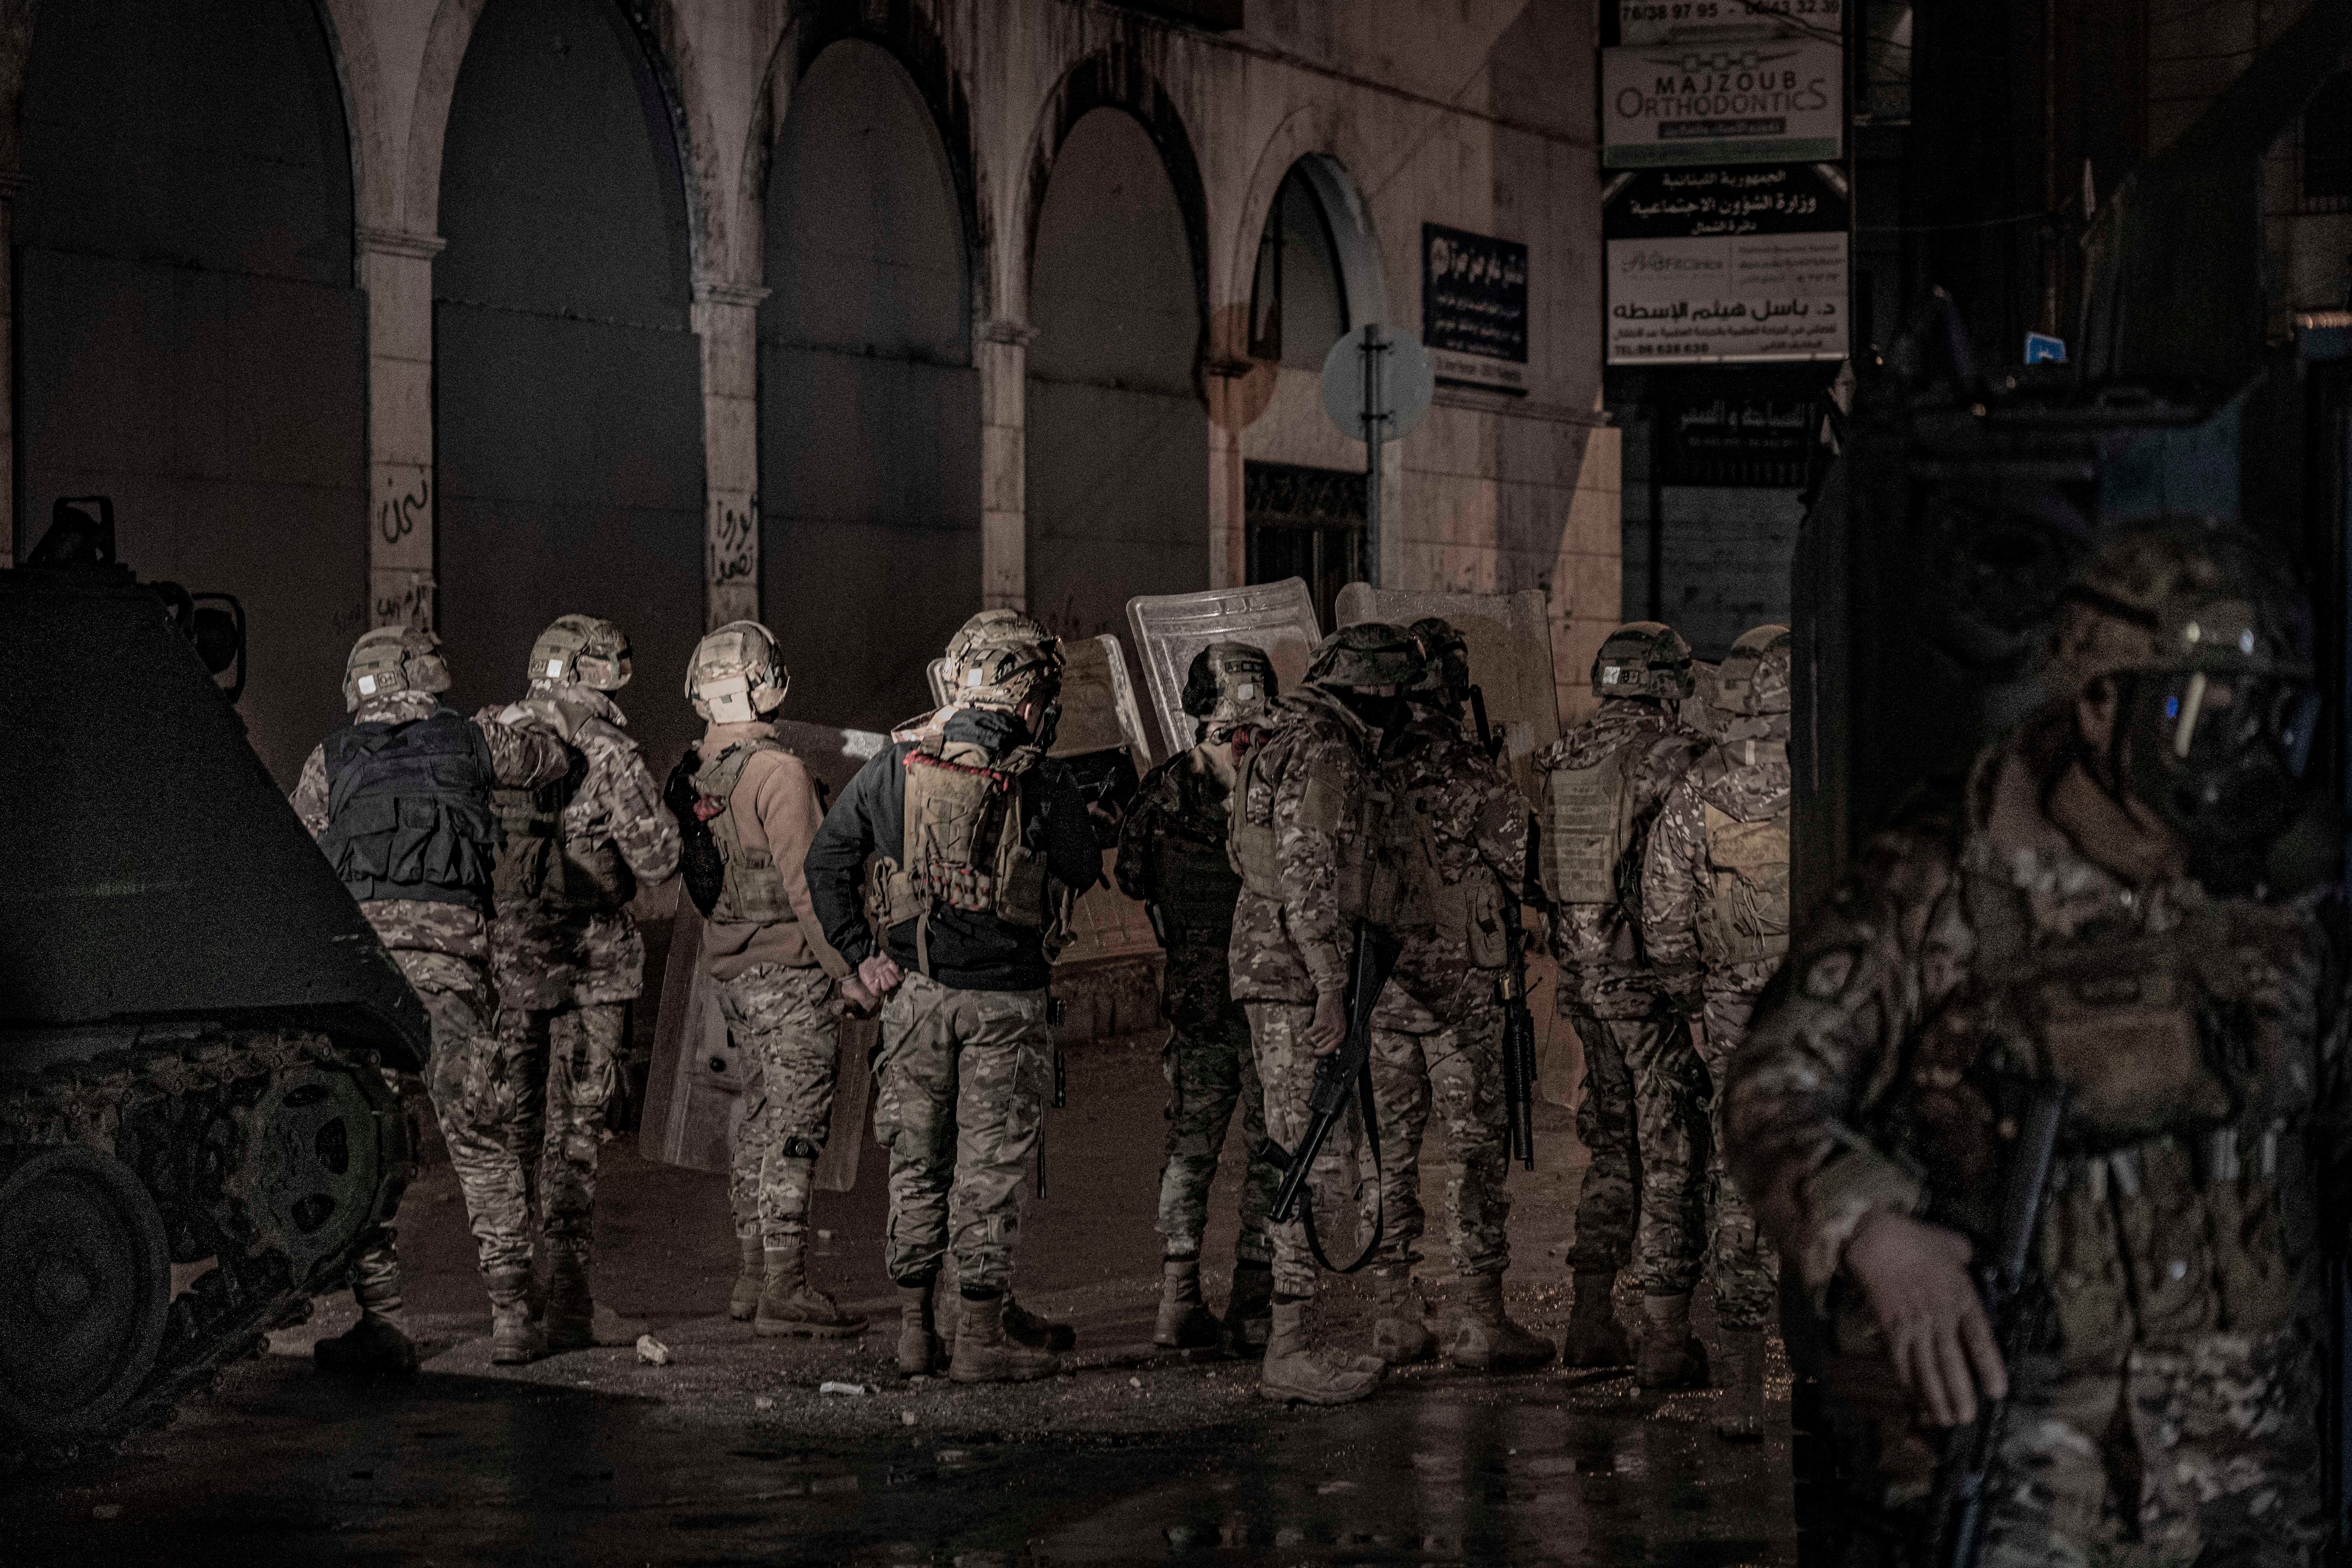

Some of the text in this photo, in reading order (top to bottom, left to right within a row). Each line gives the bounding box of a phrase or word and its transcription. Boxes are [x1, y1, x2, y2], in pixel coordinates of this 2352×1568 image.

[1655, 71, 1797, 95] MAJZOUB
[1662, 169, 1786, 191] الجمهورية اللبنانية
[1775, 192, 1818, 214] وزارة
[1693, 298, 1746, 320] هيثم
[1751, 299, 1808, 321] باسل
